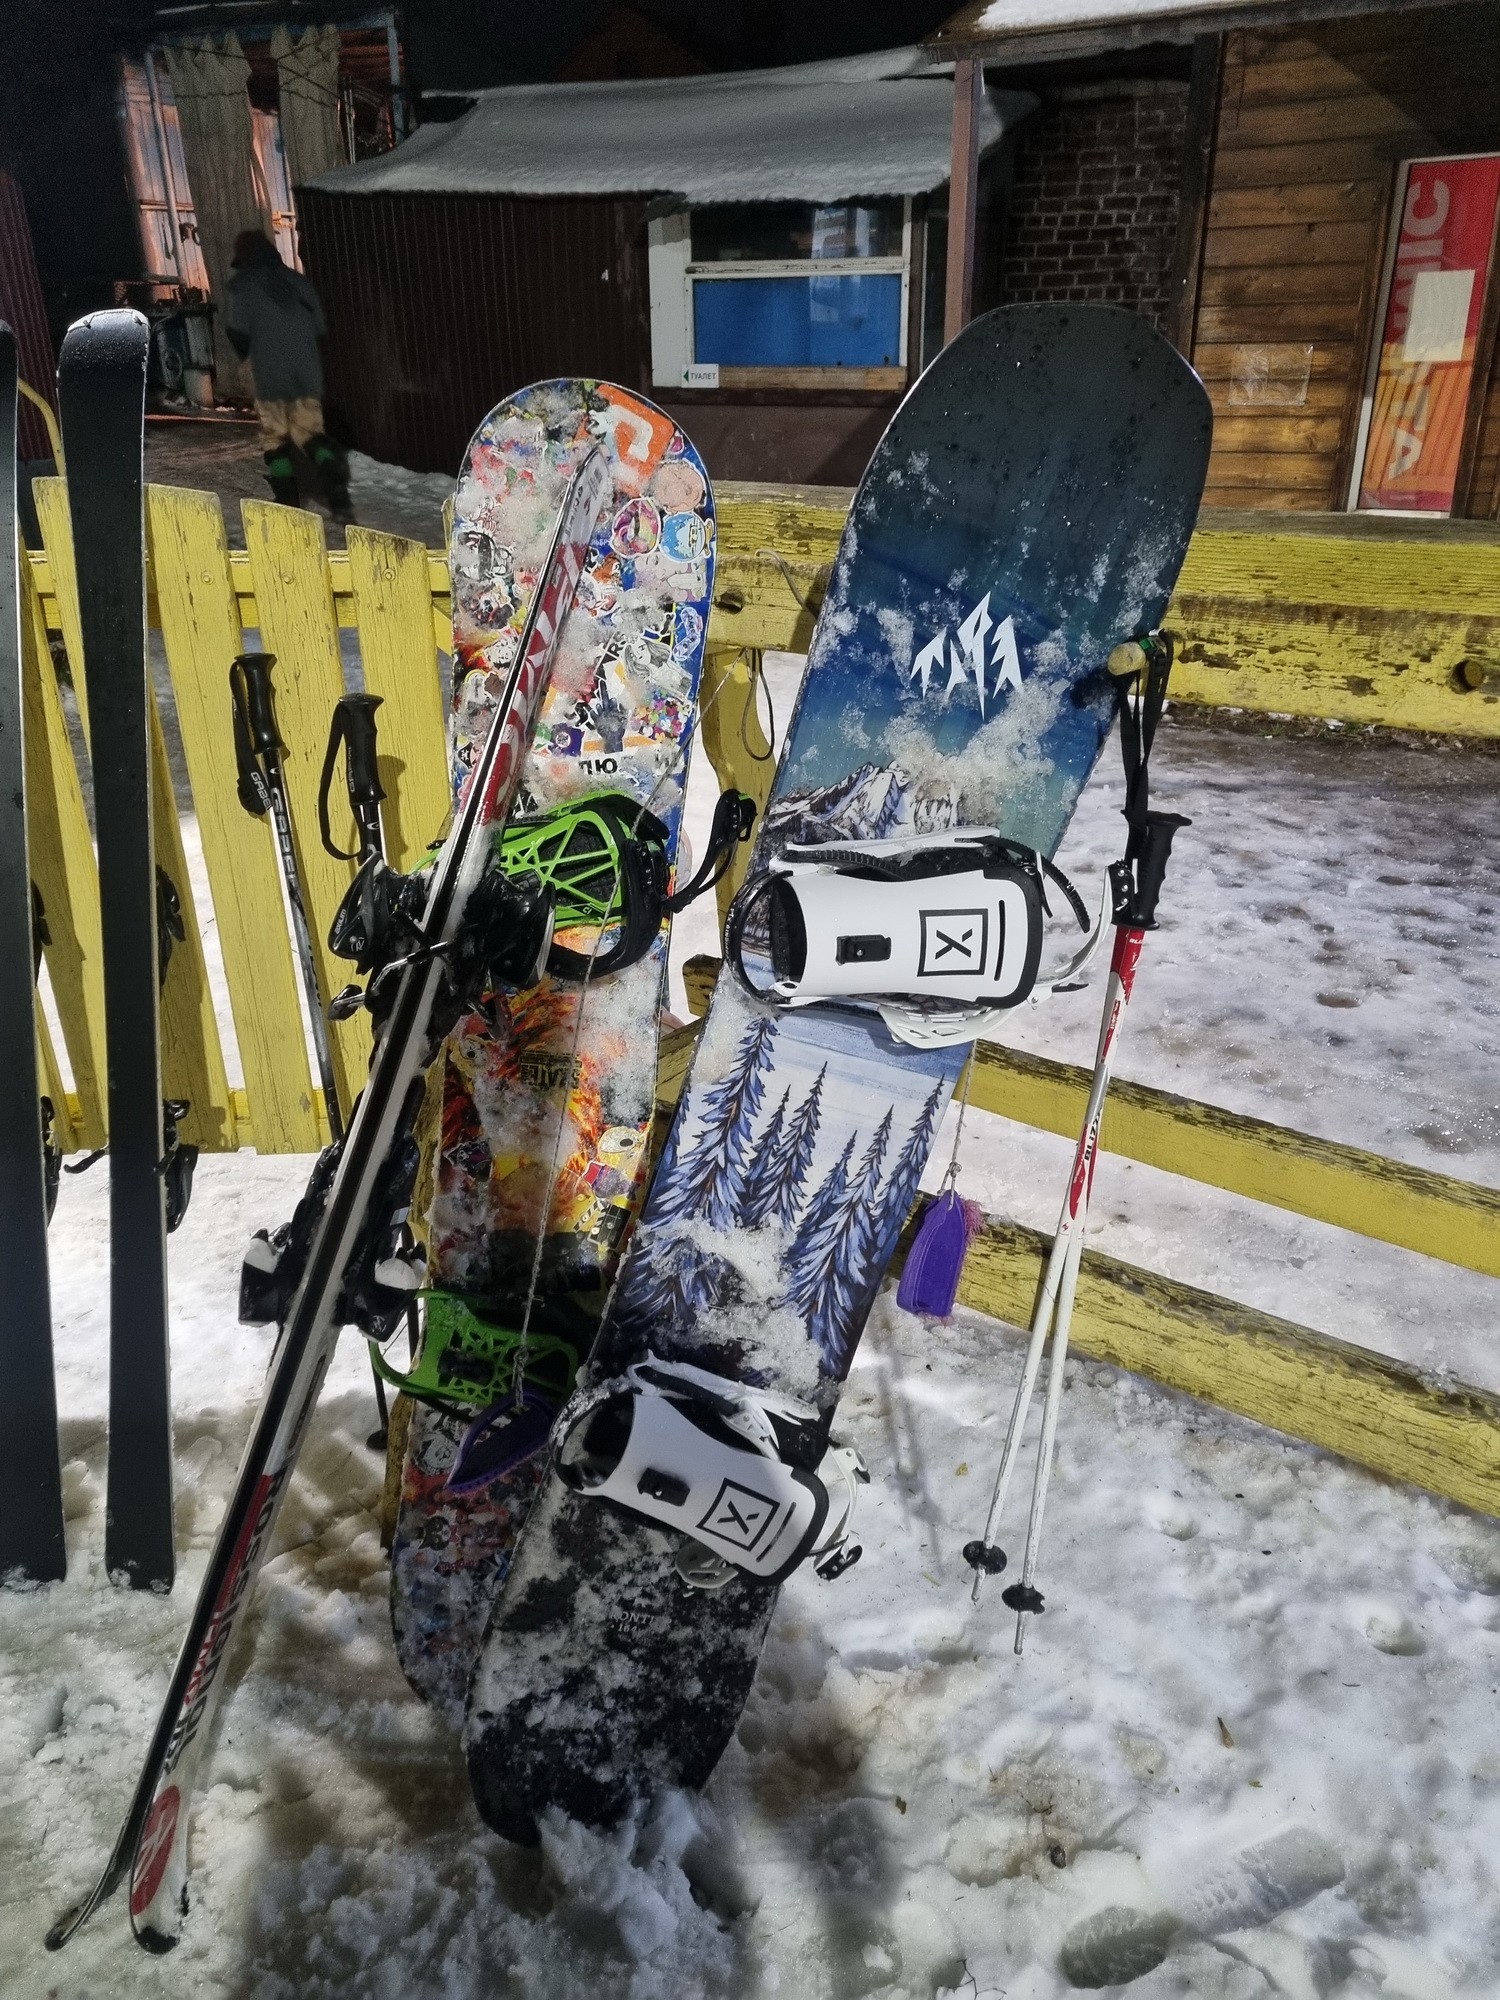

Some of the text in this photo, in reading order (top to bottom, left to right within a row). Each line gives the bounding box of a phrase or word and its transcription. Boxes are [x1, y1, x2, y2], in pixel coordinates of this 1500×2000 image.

[690, 372, 717, 380] ТУАЛЕТ
[1084, 1104, 1103, 1162] BLIZZ
[172, 1465, 288, 1770] ROSSIGNOL
